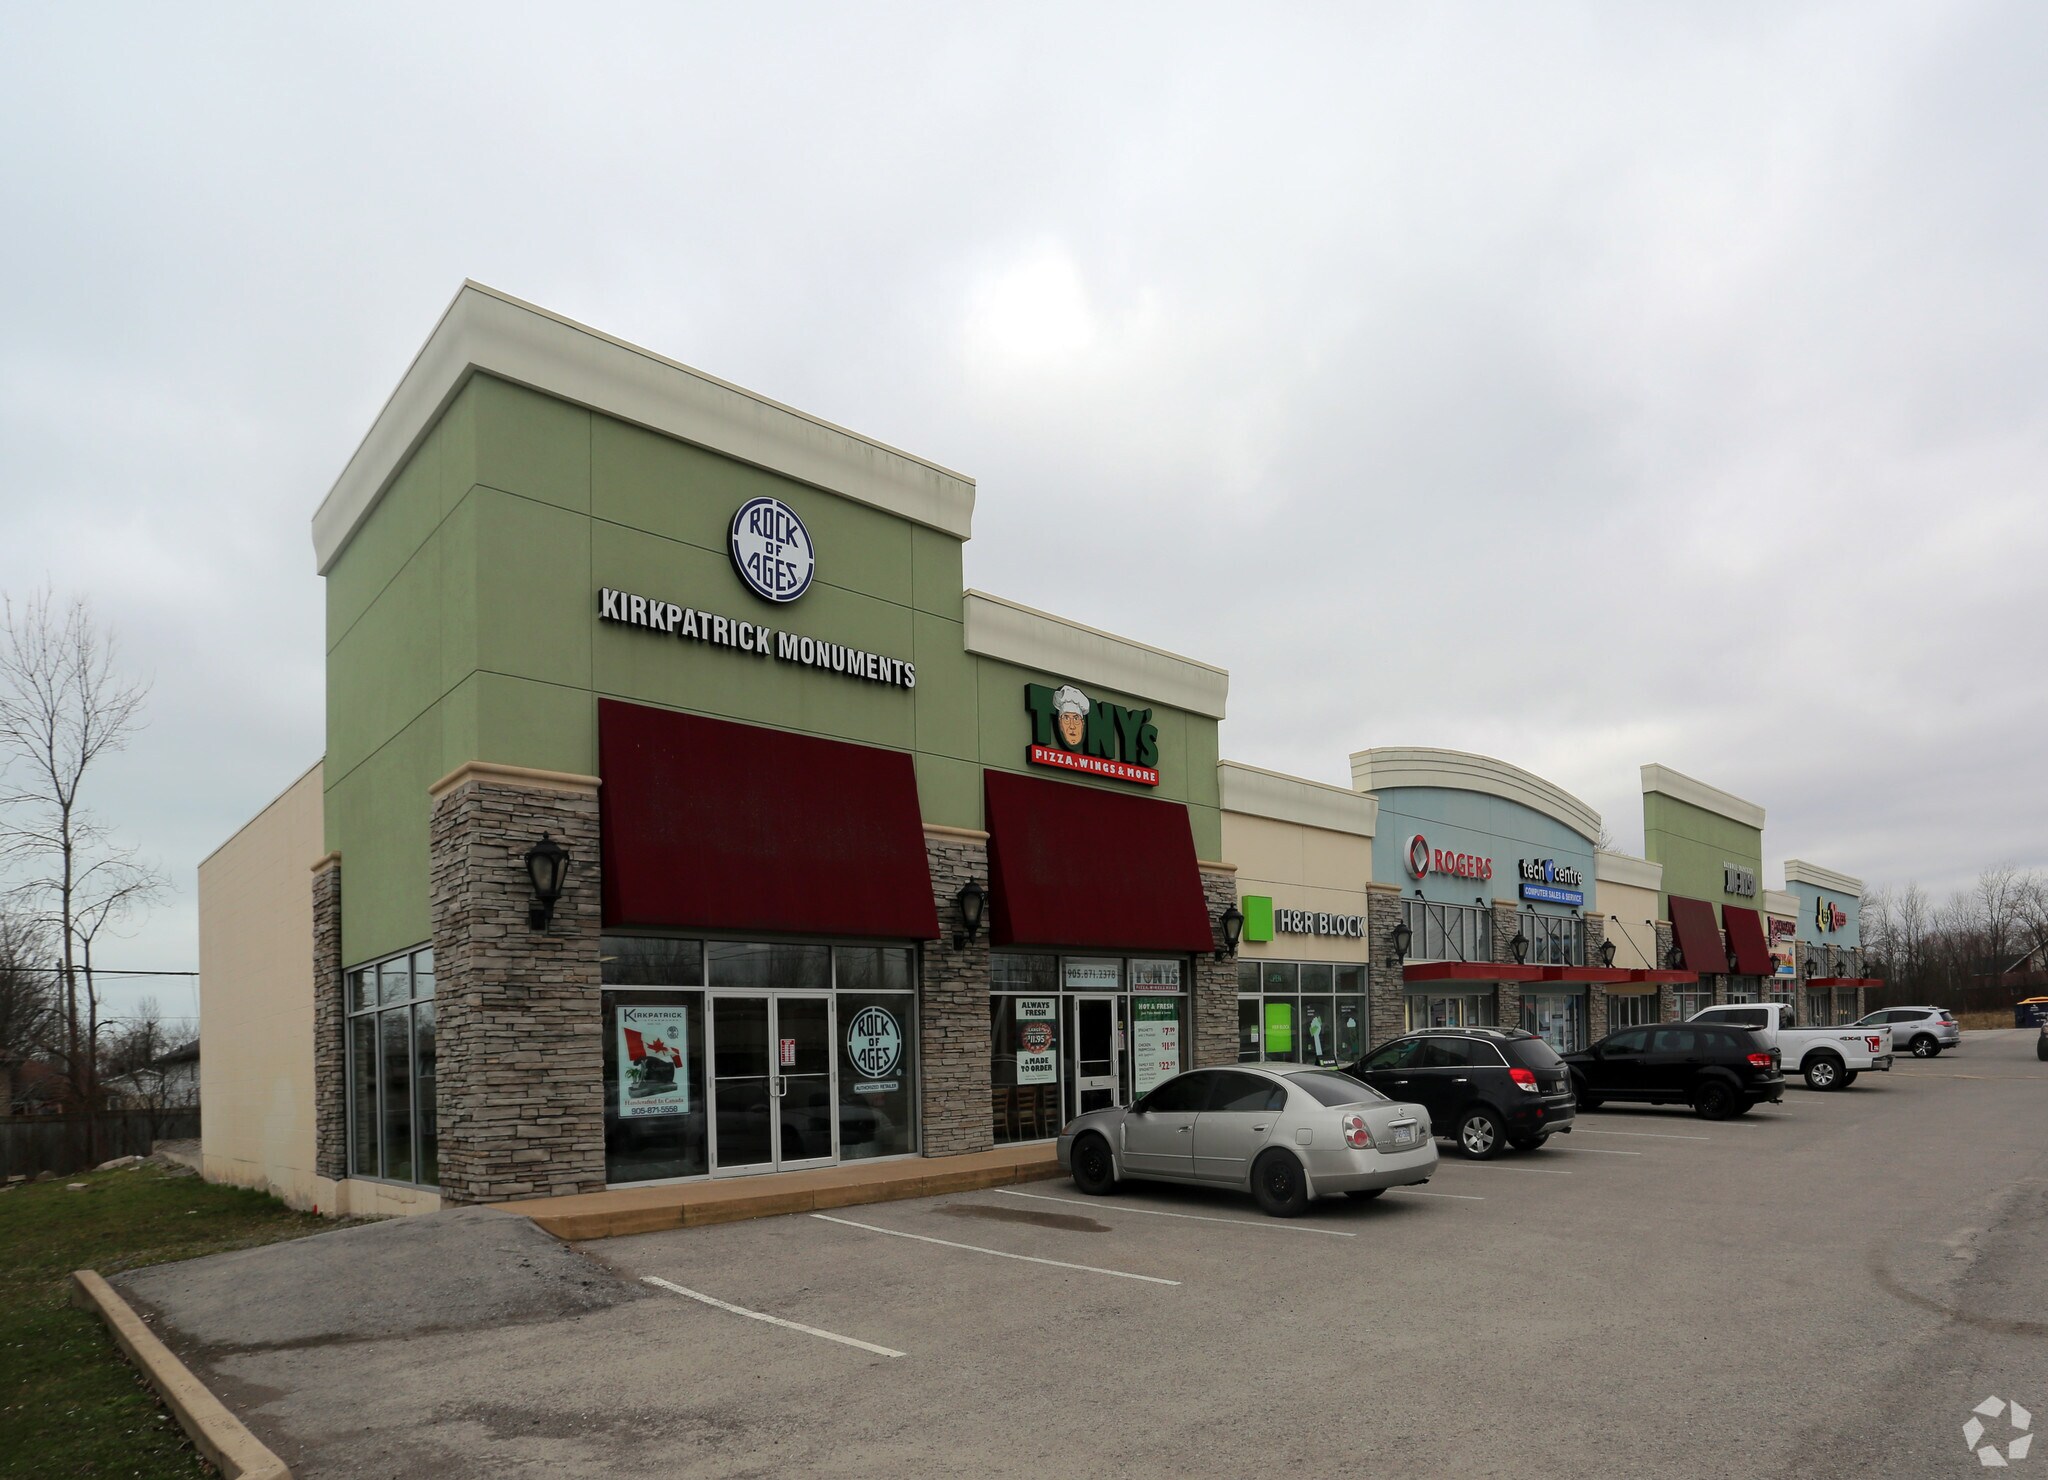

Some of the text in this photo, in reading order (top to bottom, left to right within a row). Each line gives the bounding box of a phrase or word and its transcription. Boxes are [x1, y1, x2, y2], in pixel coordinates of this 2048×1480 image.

[750, 507, 799, 549] ROCK
[765, 541, 783, 557] OF
[747, 552, 798, 591] AGES
[601, 587, 916, 688] KIRKPATRICK MONUMENTS
[1035, 749, 1156, 782] PIZZA, WINGS & MORE
[1434, 849, 1493, 880] ROGERS
[1522, 858, 1583, 885] tech centre
[1525, 886, 1548, 898] COMPUTER
[1549, 890, 1561, 900] SALES
[1565, 893, 1582, 903] SERVICE
[1280, 909, 1367, 938] H&R BLOCK
[1067, 968, 1116, 979] 905.871.2378
[624, 1008, 682, 1022] KIRKPATRICK
[858, 1014, 890, 1036] ROCK
[868, 1038, 880, 1047] OF
[858, 1047, 891, 1069] AGES
[1031, 1064, 1052, 1072] ORDER
[631, 1105, 678, 1115] 905-871-5558
